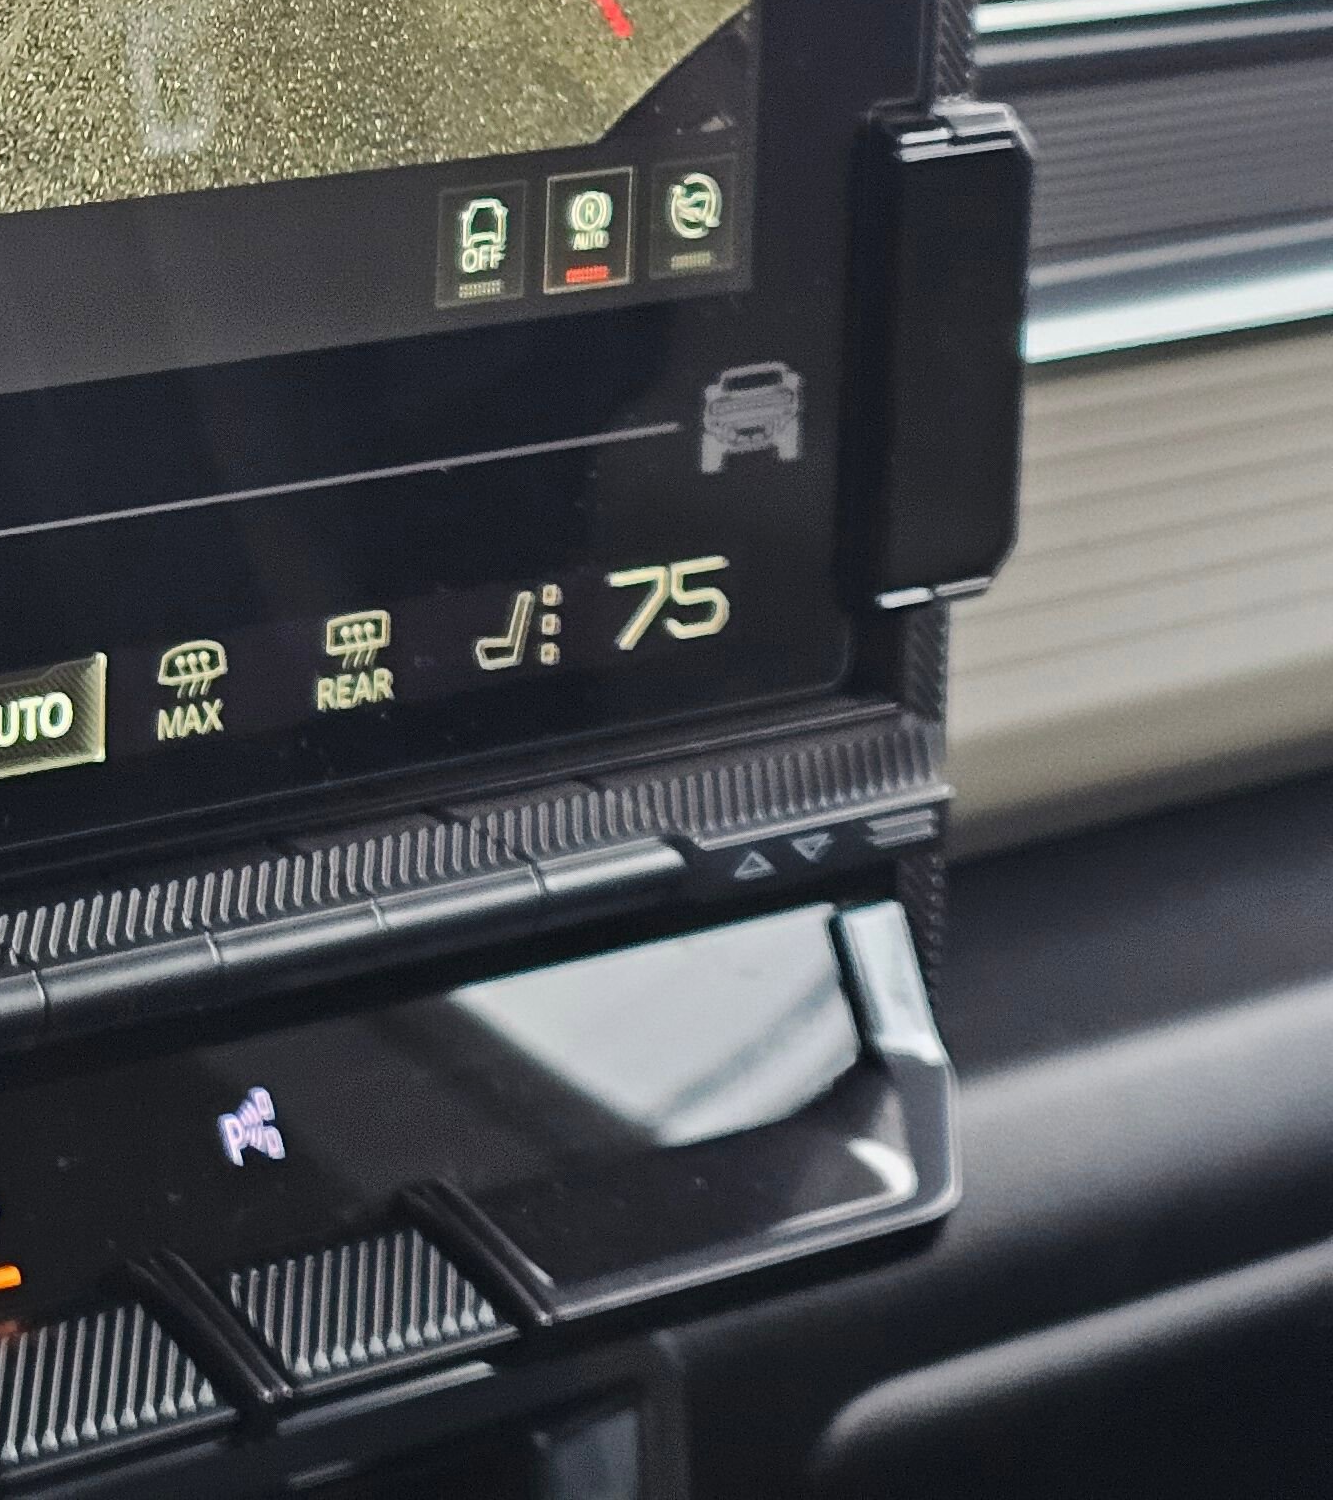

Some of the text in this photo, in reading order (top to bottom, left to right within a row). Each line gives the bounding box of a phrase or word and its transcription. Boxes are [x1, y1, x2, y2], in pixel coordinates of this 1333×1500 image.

[461, 246, 505, 273] OFF
[573, 230, 609, 250] AUTO
[605, 555, 731, 651] 75
[315, 667, 395, 713] REAR
[156, 699, 224, 741] MAX
